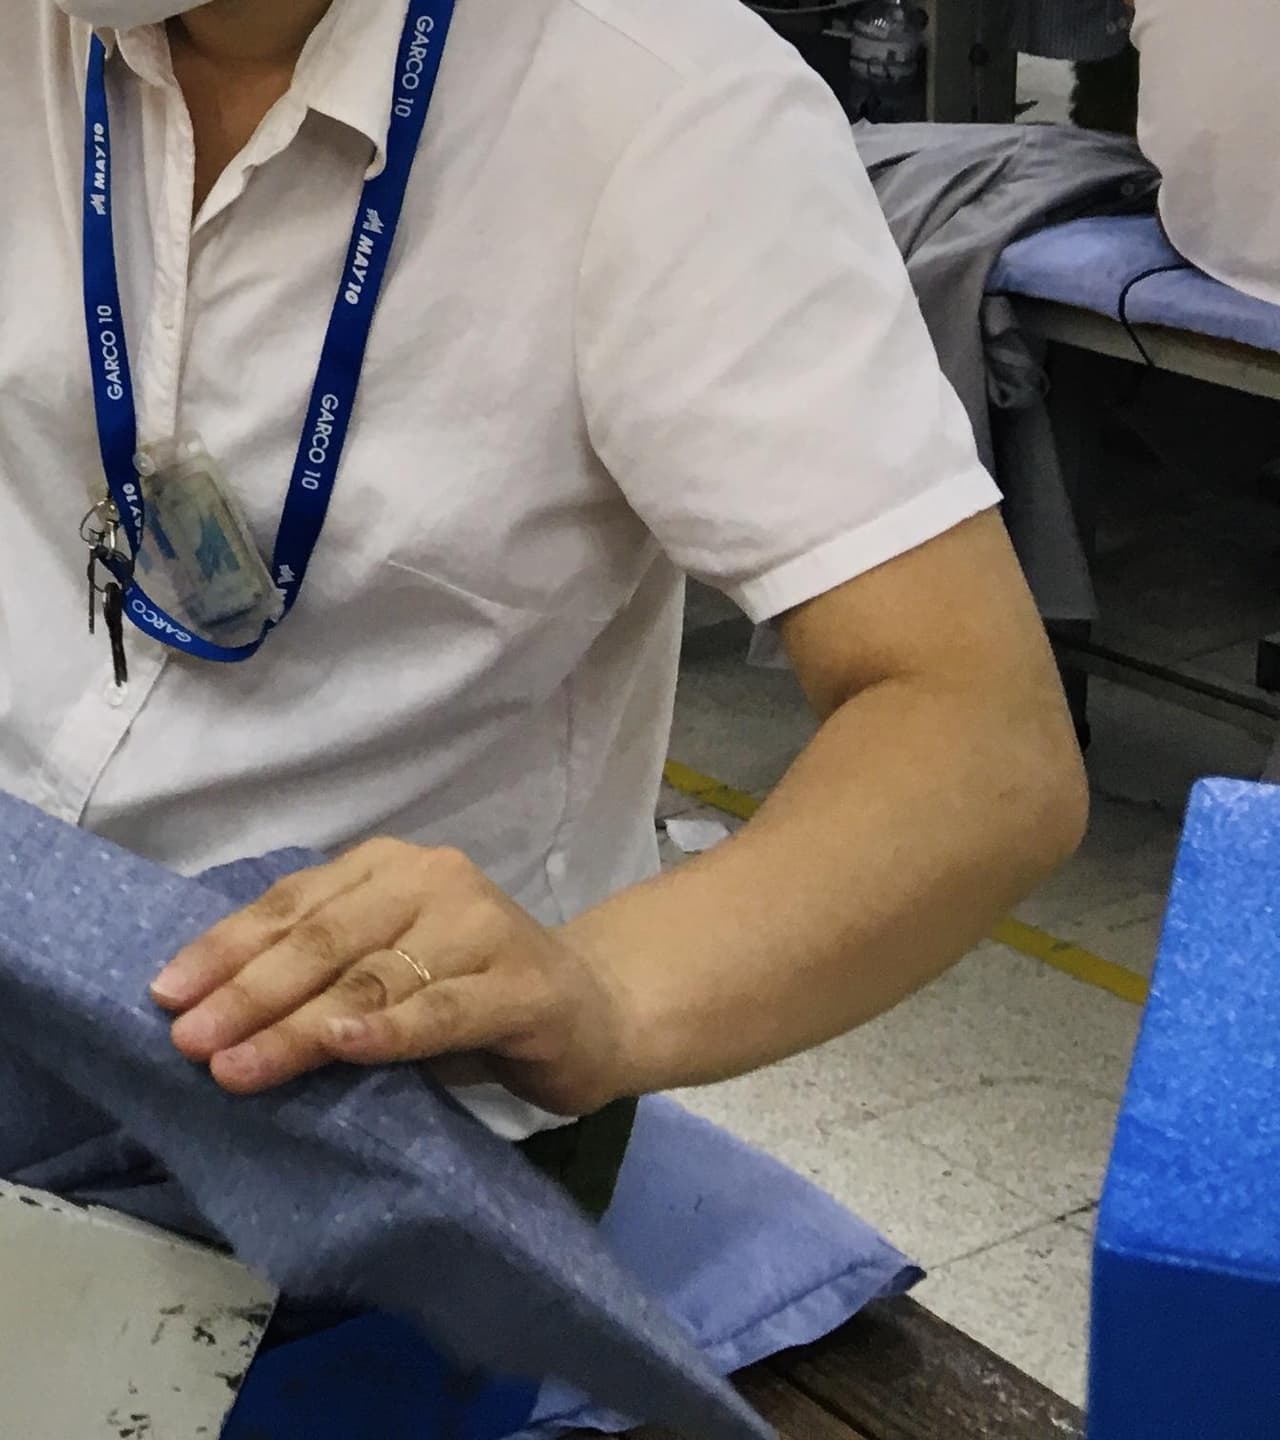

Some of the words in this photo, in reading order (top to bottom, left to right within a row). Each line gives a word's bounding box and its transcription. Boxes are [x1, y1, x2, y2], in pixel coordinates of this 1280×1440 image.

[402, 15, 435, 90] GARCO
[394, 97, 414, 118] 10
[96, 305, 113, 324] 10
[100, 330, 124, 400] GARCO
[308, 393, 339, 464] GARCO
[301, 470, 321, 490] 10
[132, 599, 192, 643] GARCO
